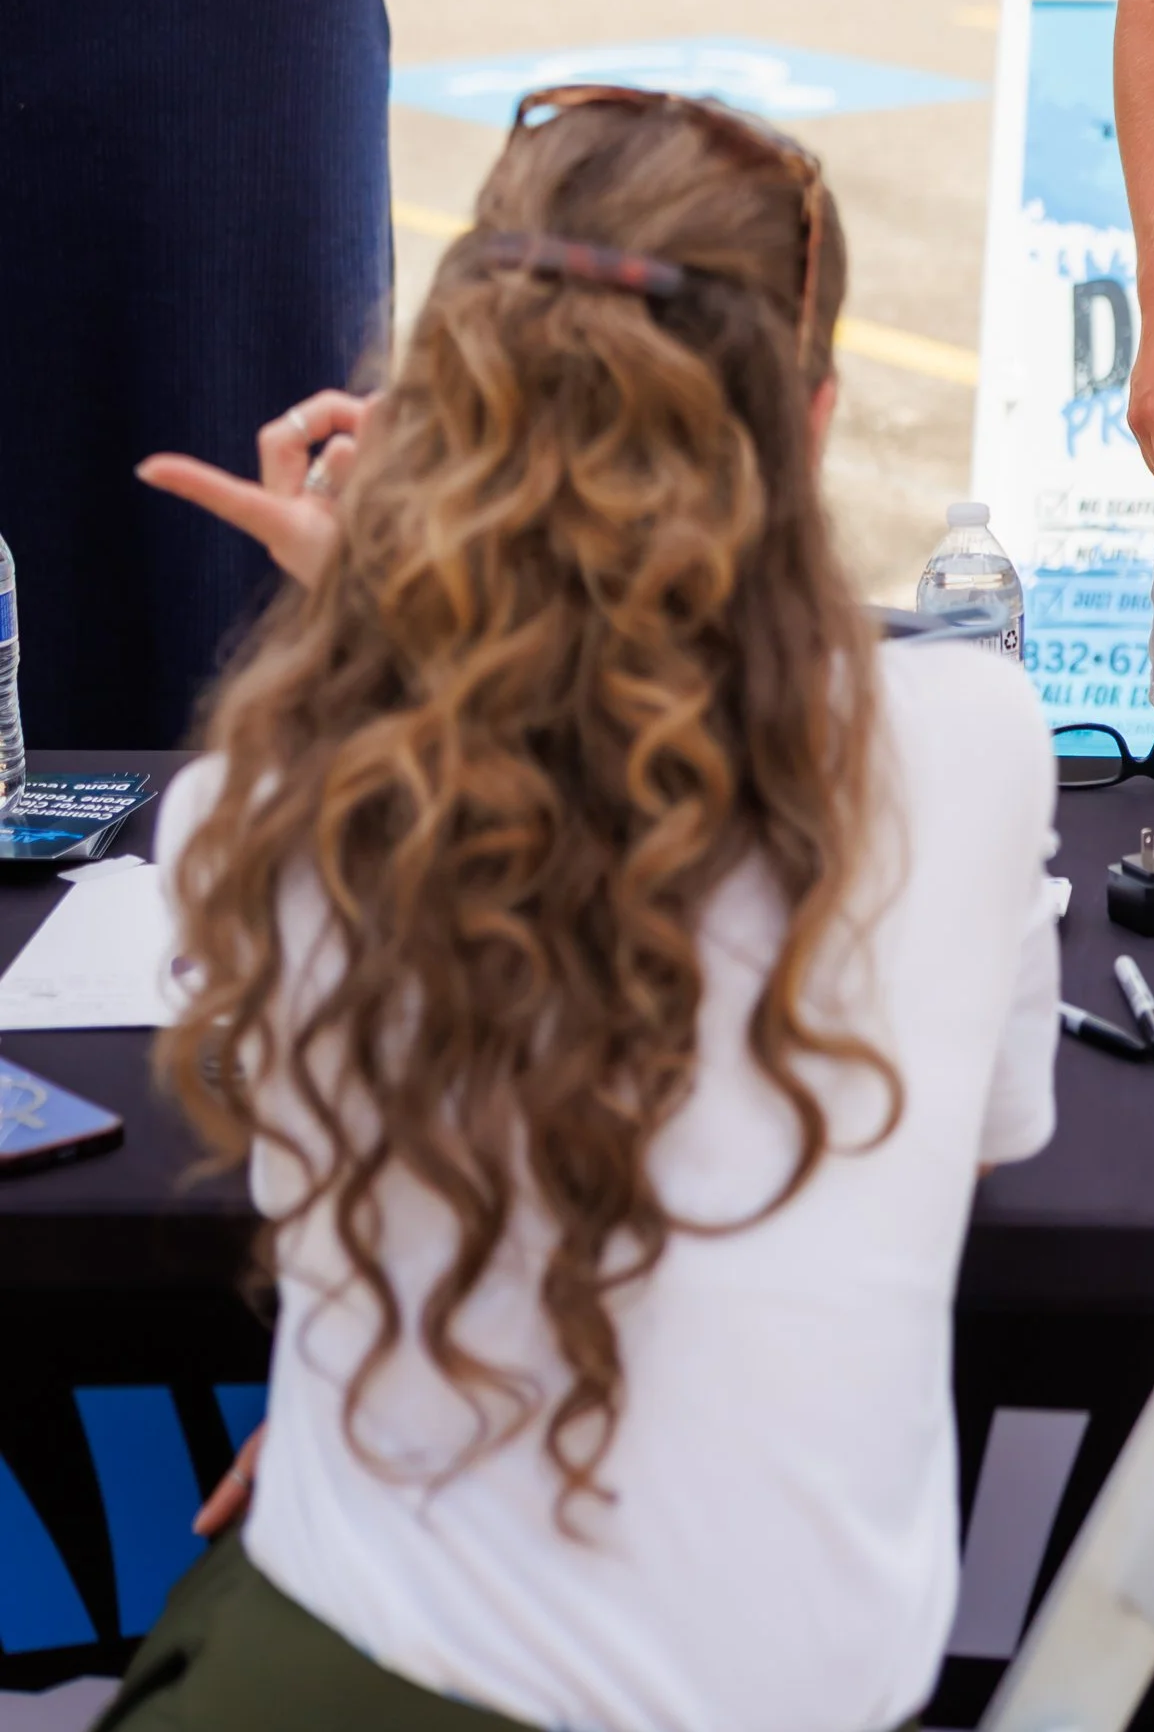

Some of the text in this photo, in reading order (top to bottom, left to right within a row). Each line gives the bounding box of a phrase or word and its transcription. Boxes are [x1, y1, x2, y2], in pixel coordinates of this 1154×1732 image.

[1034, 681, 1072, 703] ALL
[20, 792, 76, 802] Techn
[12, 807, 113, 821] Commercia
